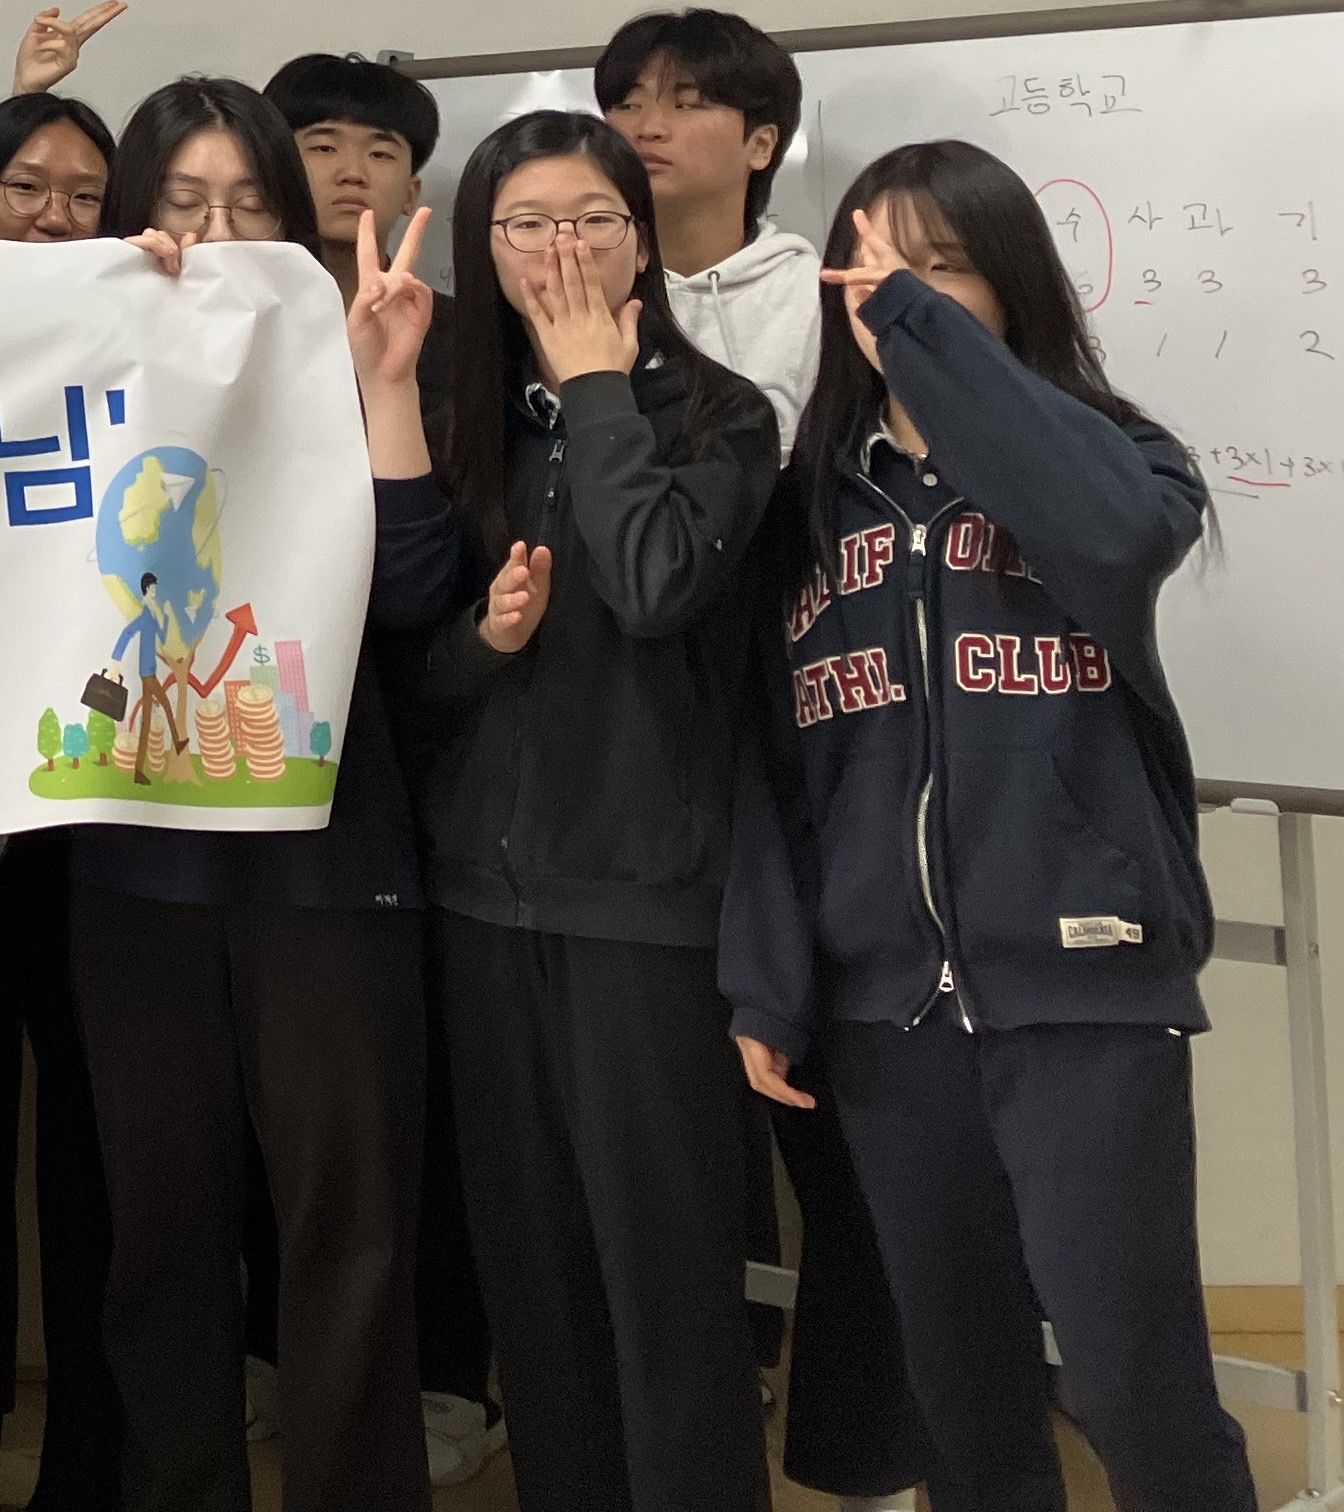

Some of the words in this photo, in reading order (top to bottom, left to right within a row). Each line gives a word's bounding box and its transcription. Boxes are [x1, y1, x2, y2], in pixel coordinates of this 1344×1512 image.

[989, 73, 1142, 118] 고등학교
[1128, 200, 1164, 230] 사
[1143, 268, 1162, 292] 3
[1198, 269, 1223, 294] 3
[1301, 268, 1327, 294] 3
[1299, 329, 1335, 360] 2
[955, 633, 1112, 696] CLUB
